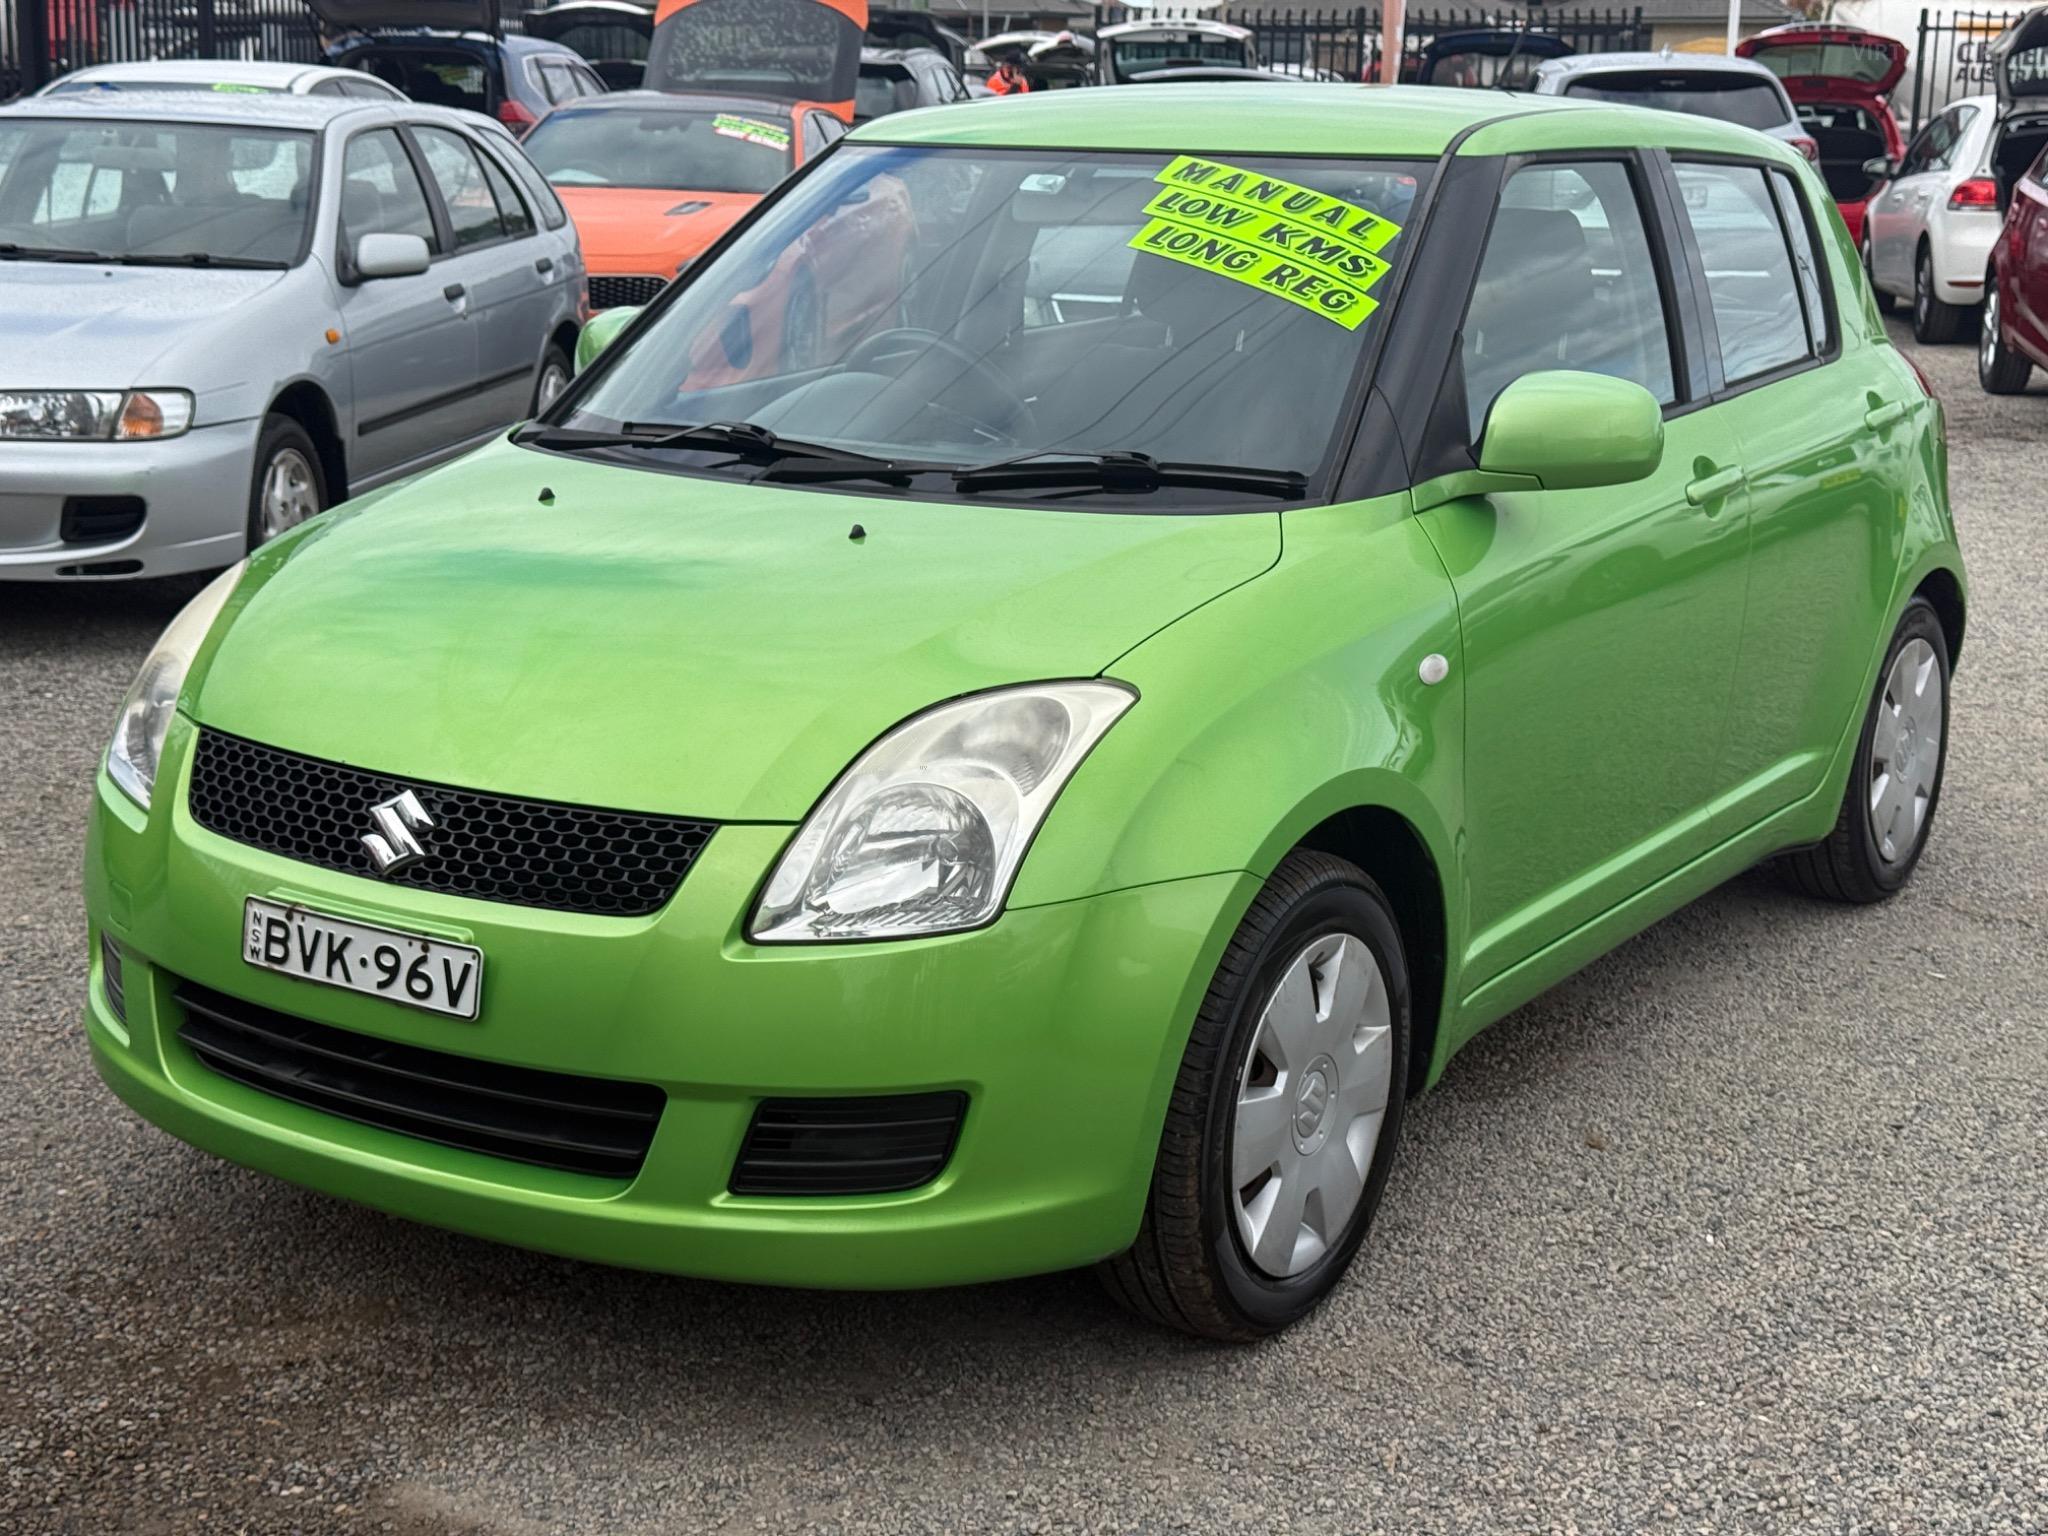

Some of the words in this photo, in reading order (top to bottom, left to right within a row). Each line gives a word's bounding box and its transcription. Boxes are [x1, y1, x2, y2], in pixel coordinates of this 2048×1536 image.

[1156, 191, 1259, 229] LOW
[1258, 222, 1378, 277] KMS
[1171, 161, 1381, 239] MANUAL
[1145, 225, 1262, 272] LONG
[1261, 263, 1359, 313] REG
[250, 910, 262, 961] NSW
